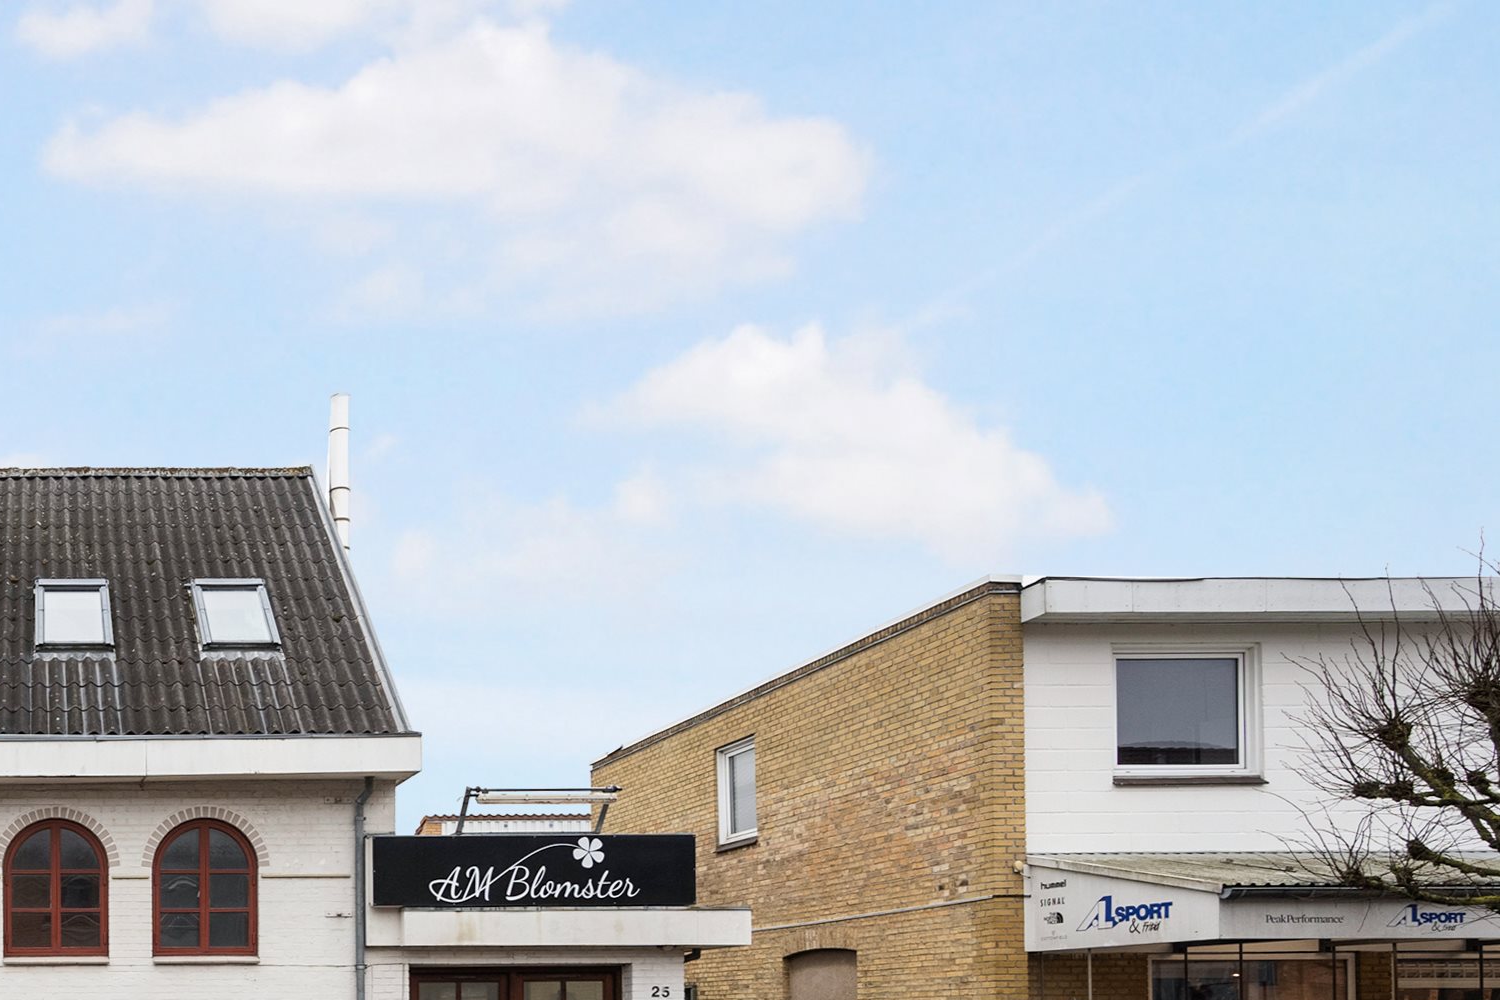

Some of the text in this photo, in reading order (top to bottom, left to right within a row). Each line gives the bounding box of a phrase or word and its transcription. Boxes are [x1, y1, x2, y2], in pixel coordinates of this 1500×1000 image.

[428, 865, 640, 903] AM Blomster
[1040, 897, 1066, 907] SIGNAL
[1129, 918, 1141, 934] &
[651, 986, 670, 998] 25
